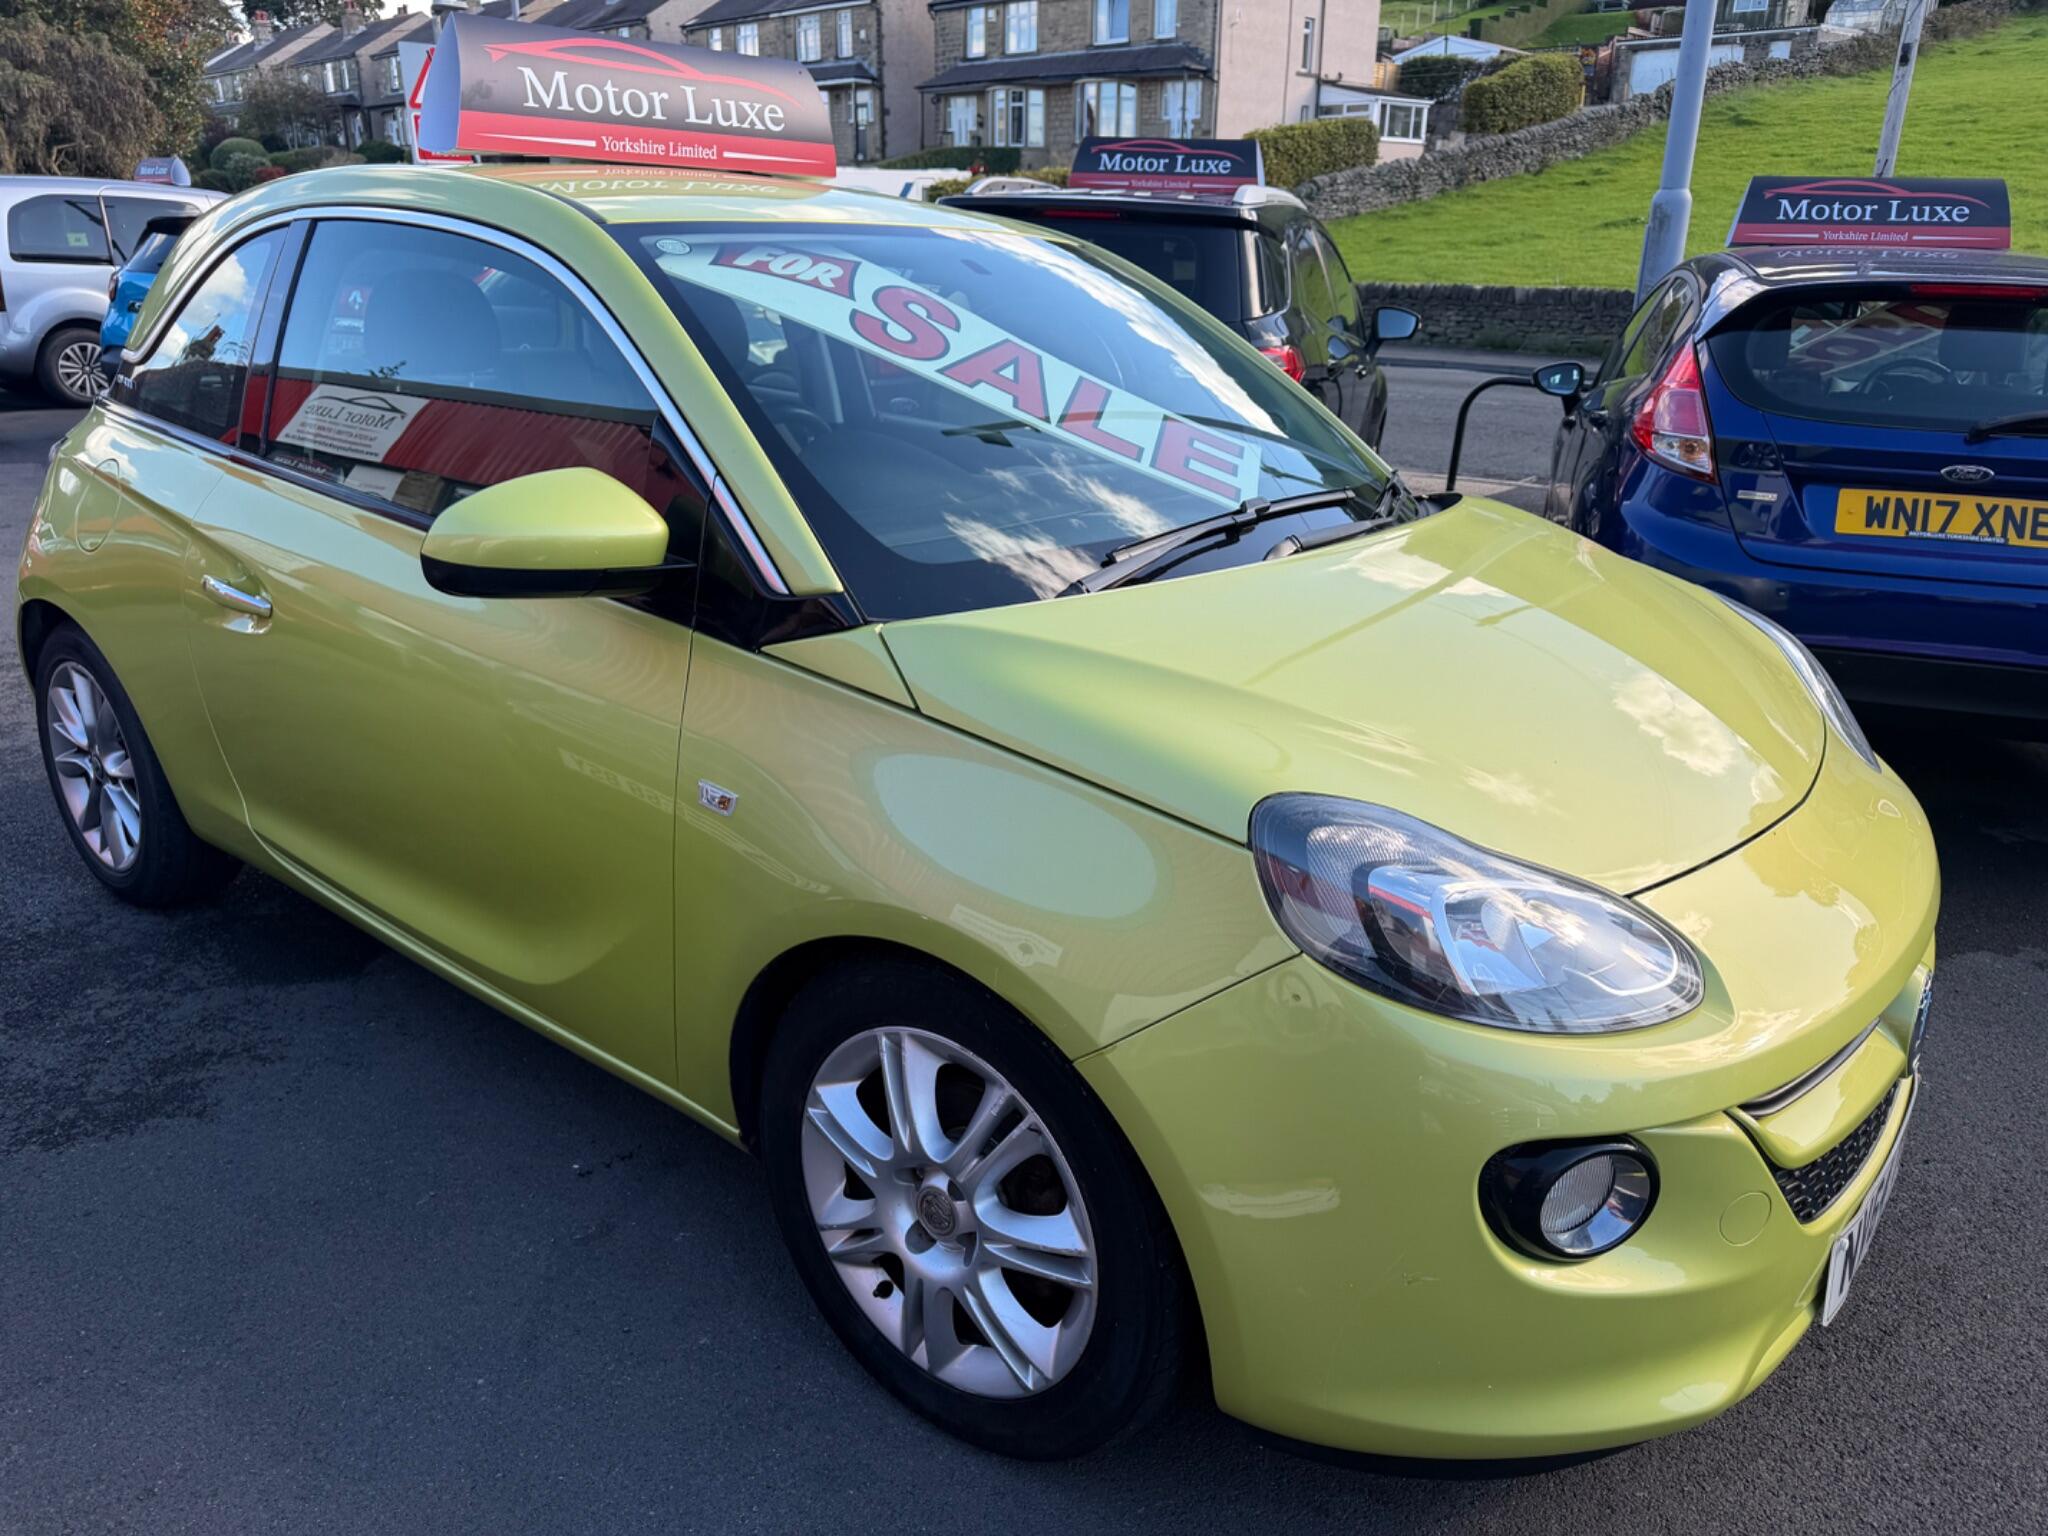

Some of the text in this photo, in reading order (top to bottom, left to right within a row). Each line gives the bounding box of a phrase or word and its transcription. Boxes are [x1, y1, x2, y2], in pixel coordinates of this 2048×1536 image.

[517, 66, 785, 132] Motor Luxe
[602, 136, 718, 160] Yorkshire Limited
[1098, 153, 1232, 174] Motor Luxe
[1776, 199, 1970, 222] Motor Luxe
[1823, 231, 1908, 242] Yorkshire Limited
[734, 244, 845, 290] FOR
[849, 285, 1246, 500] SALE
[1865, 496, 2048, 542] WN17 XNE
